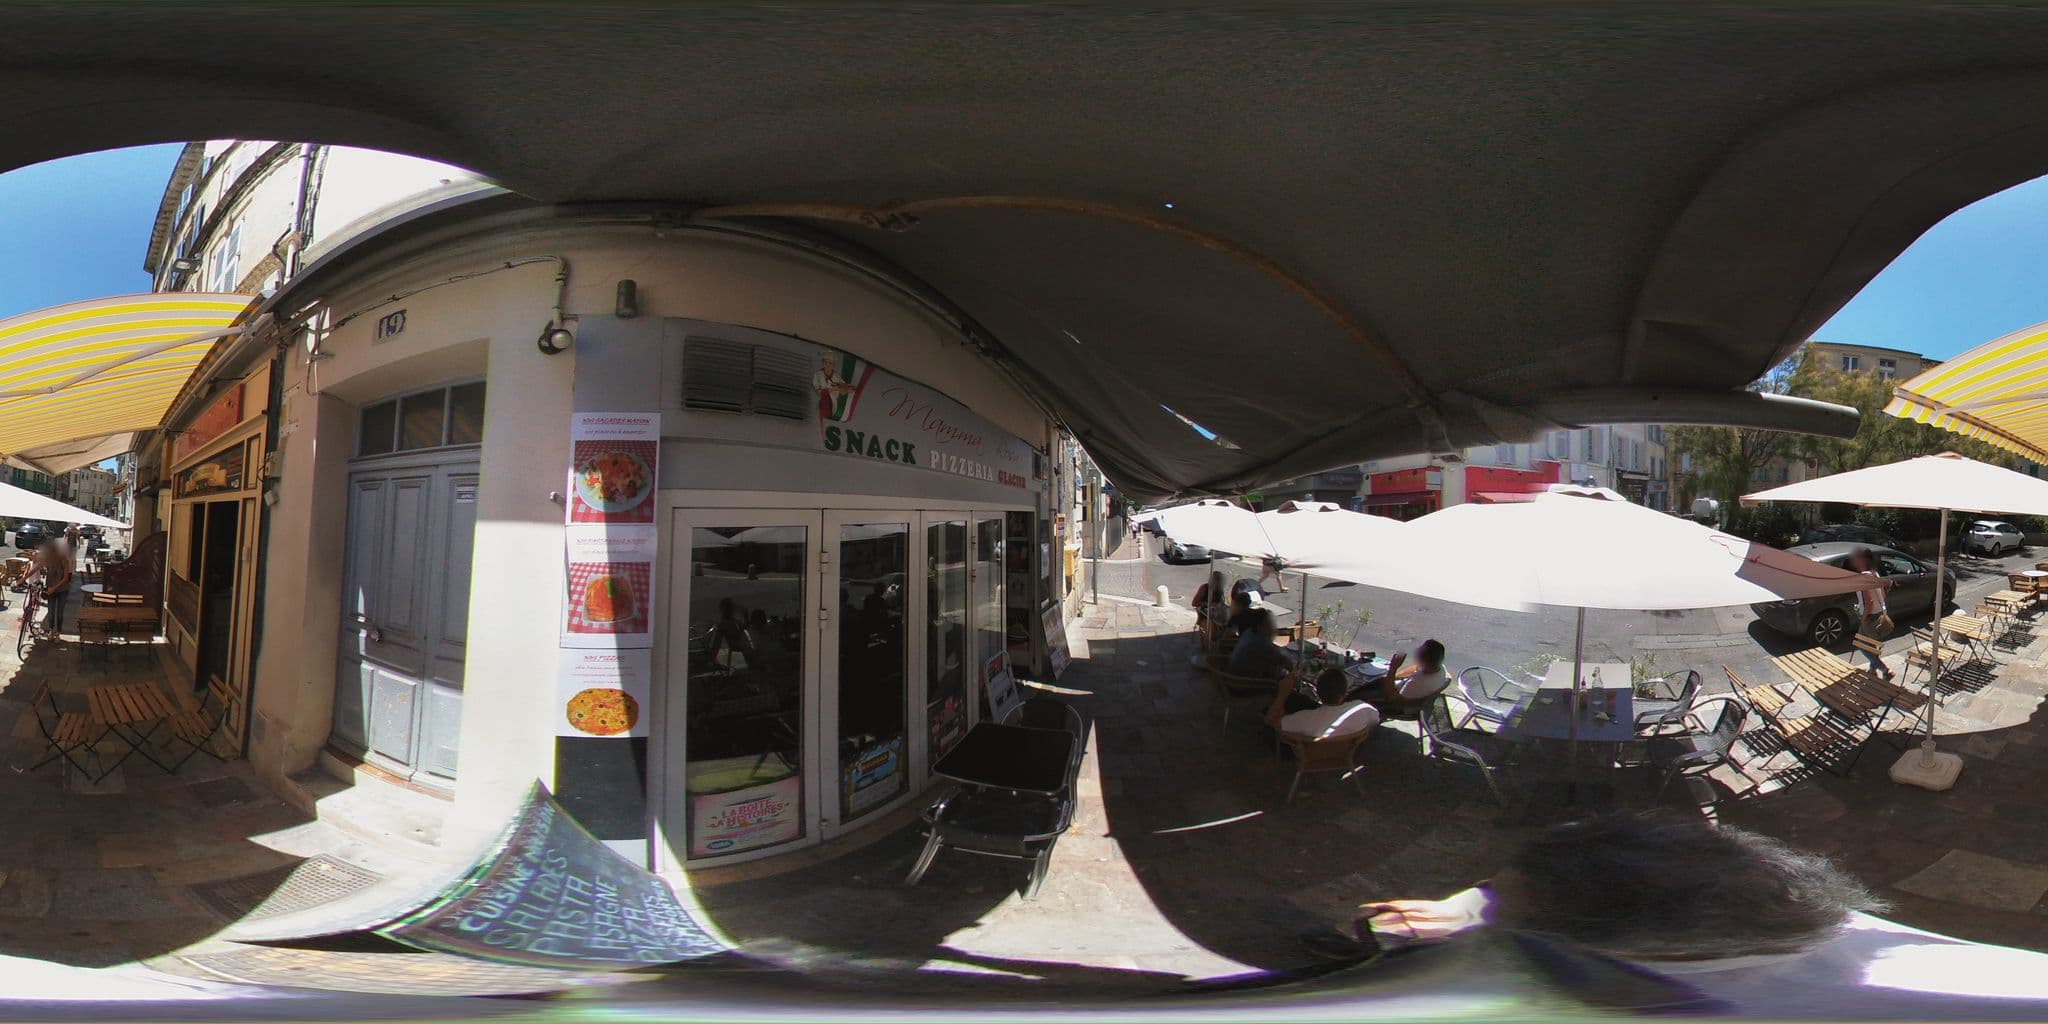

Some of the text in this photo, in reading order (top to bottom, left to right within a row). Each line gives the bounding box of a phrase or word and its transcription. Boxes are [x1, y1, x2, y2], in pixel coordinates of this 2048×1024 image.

[380, 313, 403, 338] 19
[824, 425, 916, 465] SNACK
[930, 451, 993, 481] PIZZERIA
[998, 470, 1026, 489] GLACIER
[458, 863, 536, 932] CUISINE
[484, 849, 568, 949] SALADES
[526, 875, 593, 957] PASTA
[577, 876, 634, 962] LASAGNE
[621, 907, 681, 963] PIZZA
